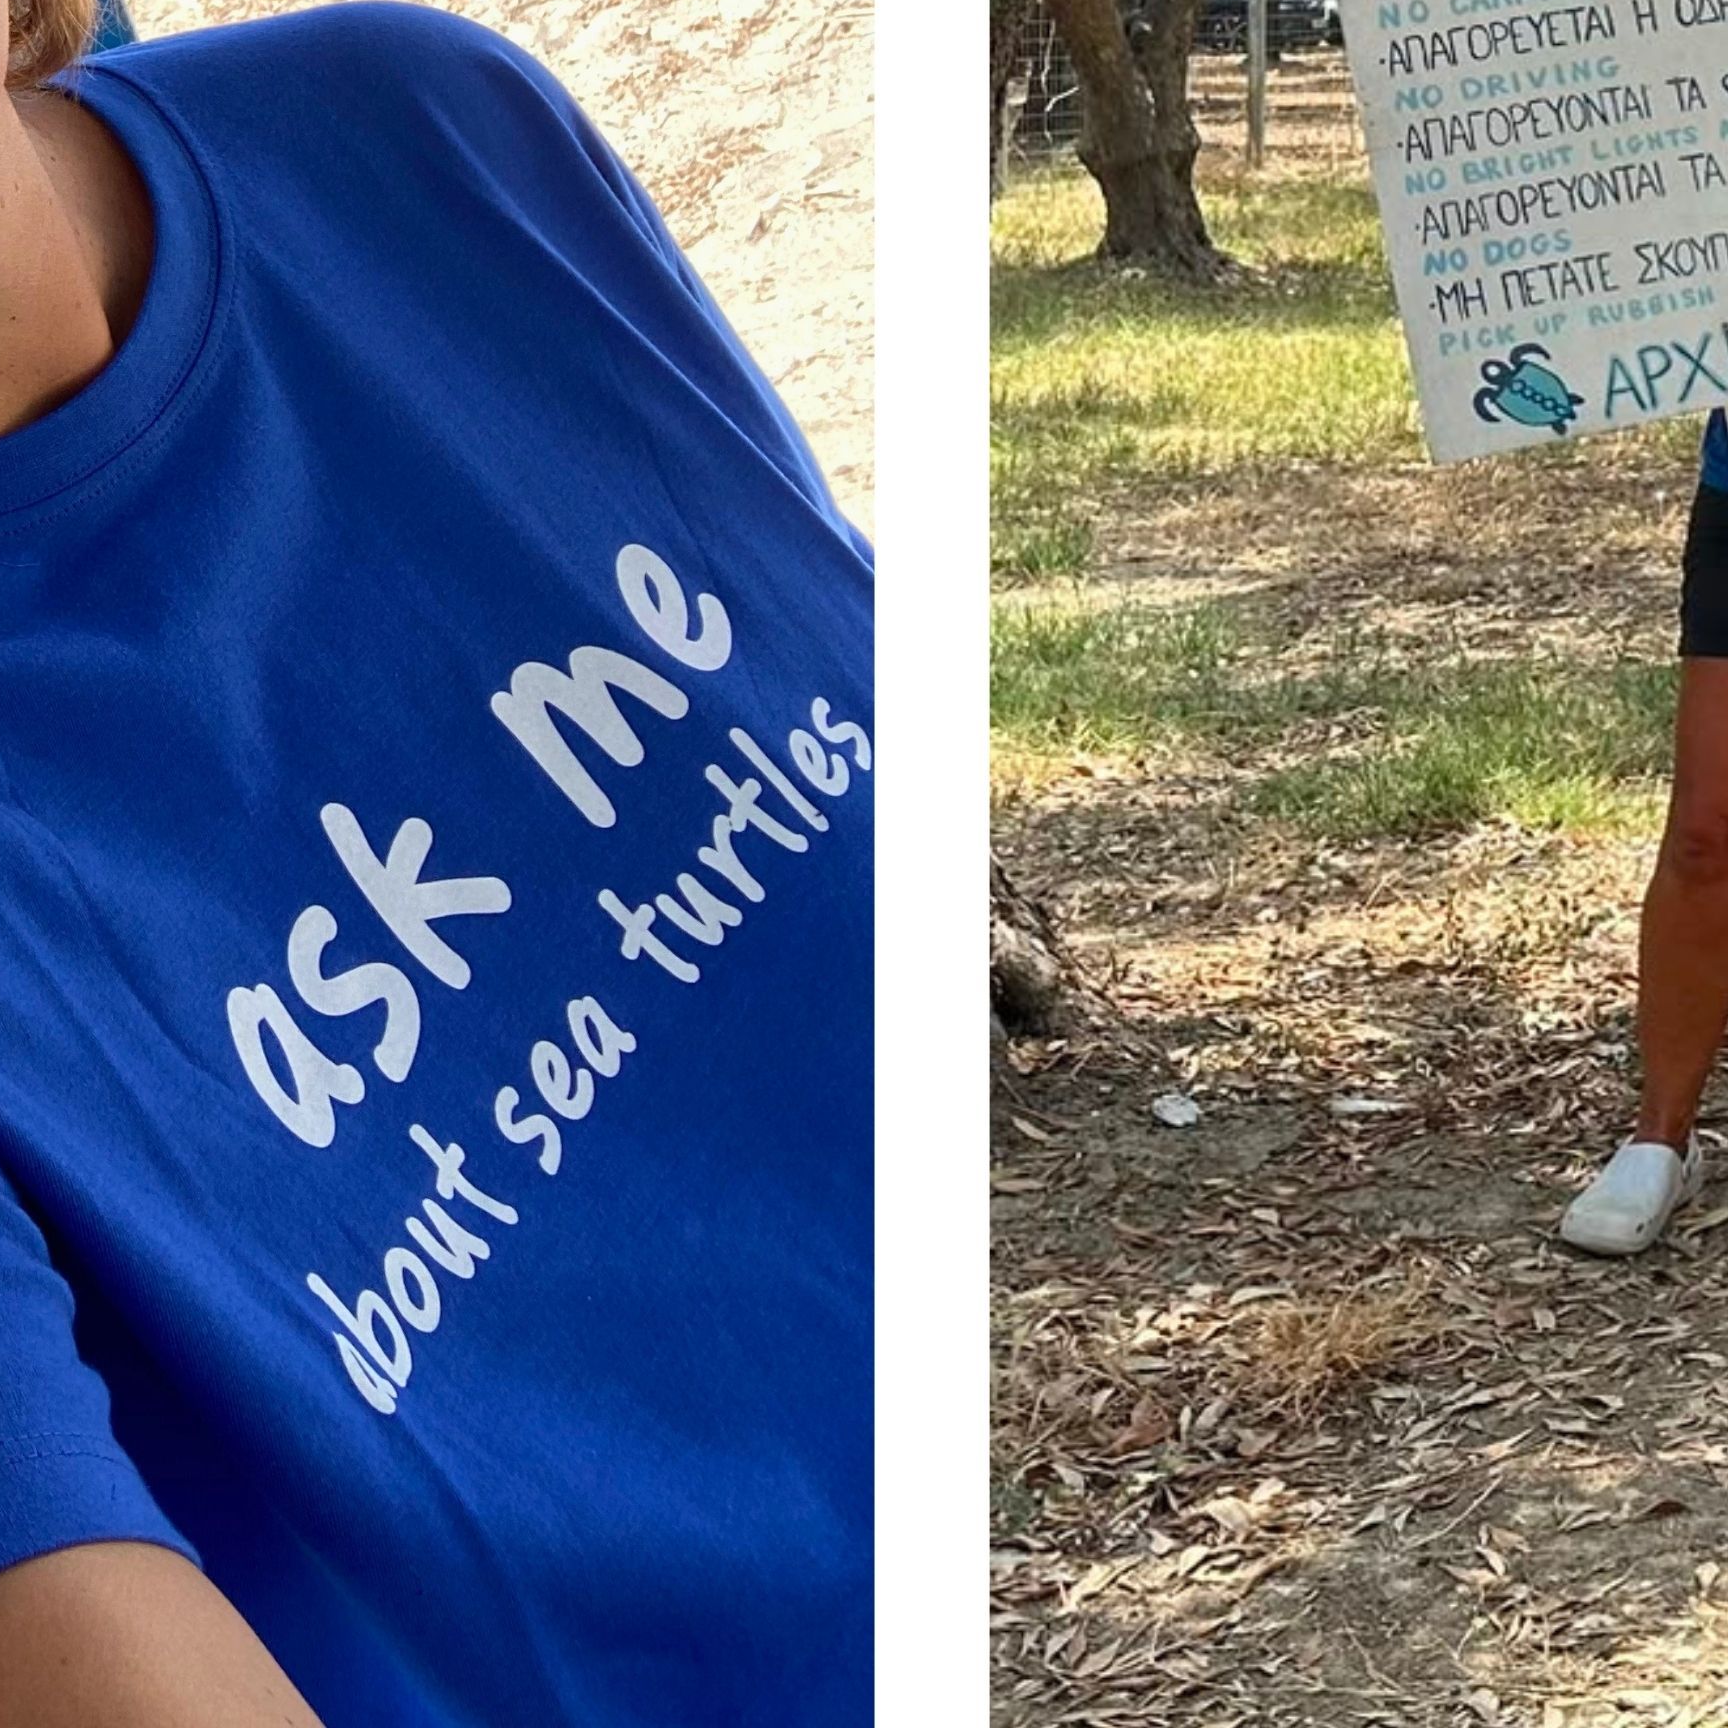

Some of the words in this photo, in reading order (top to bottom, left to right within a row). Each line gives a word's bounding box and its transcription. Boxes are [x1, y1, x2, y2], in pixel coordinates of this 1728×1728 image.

[1379, 0, 1429, 28] NO
[1394, 84, 1443, 112] NO
[1461, 56, 1620, 101] DRIVING
[1666, 77, 1707, 112] ΤΑ
[1405, 168, 1446, 195] NO
[1462, 145, 1573, 185] BRIGHT
[1591, 126, 1698, 160] LIGHTS
[1679, 153, 1727, 192] ΤΑ
[1424, 248, 1468, 275] NO
[1483, 229, 1571, 267] DOGS
[1501, 252, 1620, 313] ΠΕΤΑΤΕ
[1439, 321, 1517, 356] PICK
[1534, 312, 1569, 338] UP
[1589, 285, 1716, 327] RUBBISH
[227, 802, 512, 1149] ask
[491, 544, 733, 828] me
[306, 1123, 519, 1414] about
[495, 995, 637, 1176] sea
[598, 697, 870, 984] turtles
